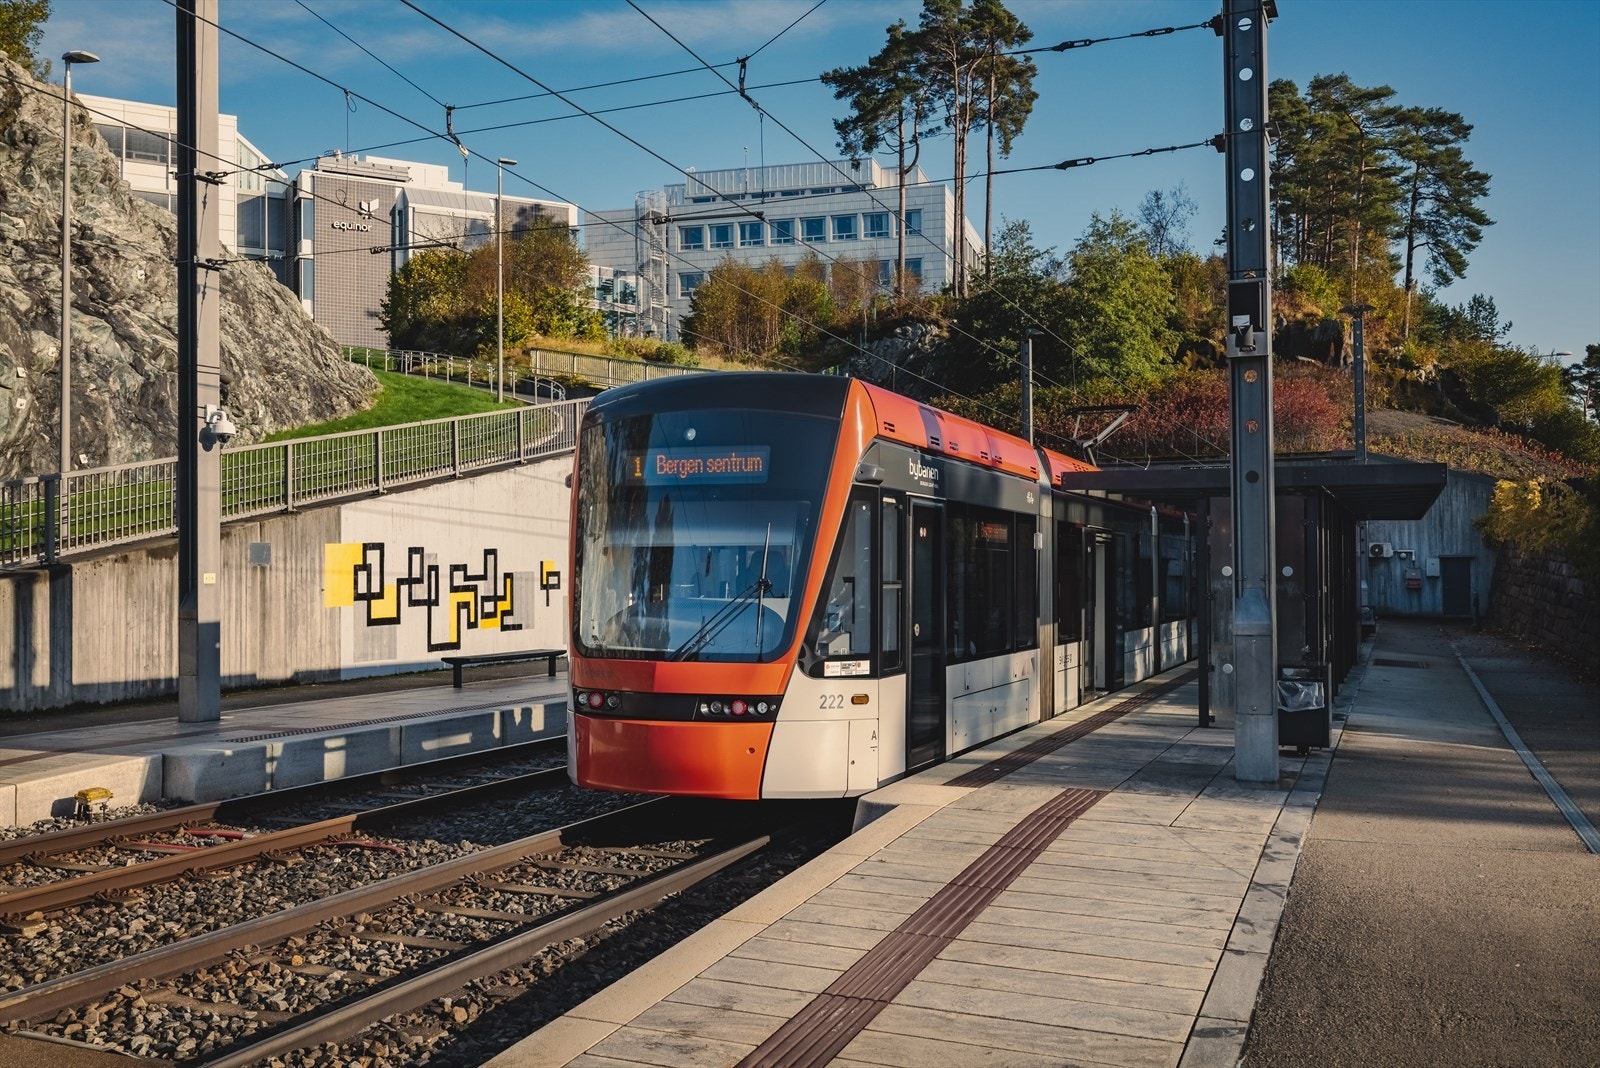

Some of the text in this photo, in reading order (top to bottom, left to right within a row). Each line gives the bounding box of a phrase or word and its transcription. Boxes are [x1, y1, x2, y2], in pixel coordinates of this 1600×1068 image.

[332, 220, 372, 232] equinor
[634, 452, 763, 479] 1 Bergen sentrum
[909, 457, 939, 480] bybanen
[819, 694, 844, 709] 222
[871, 730, 877, 740] A
